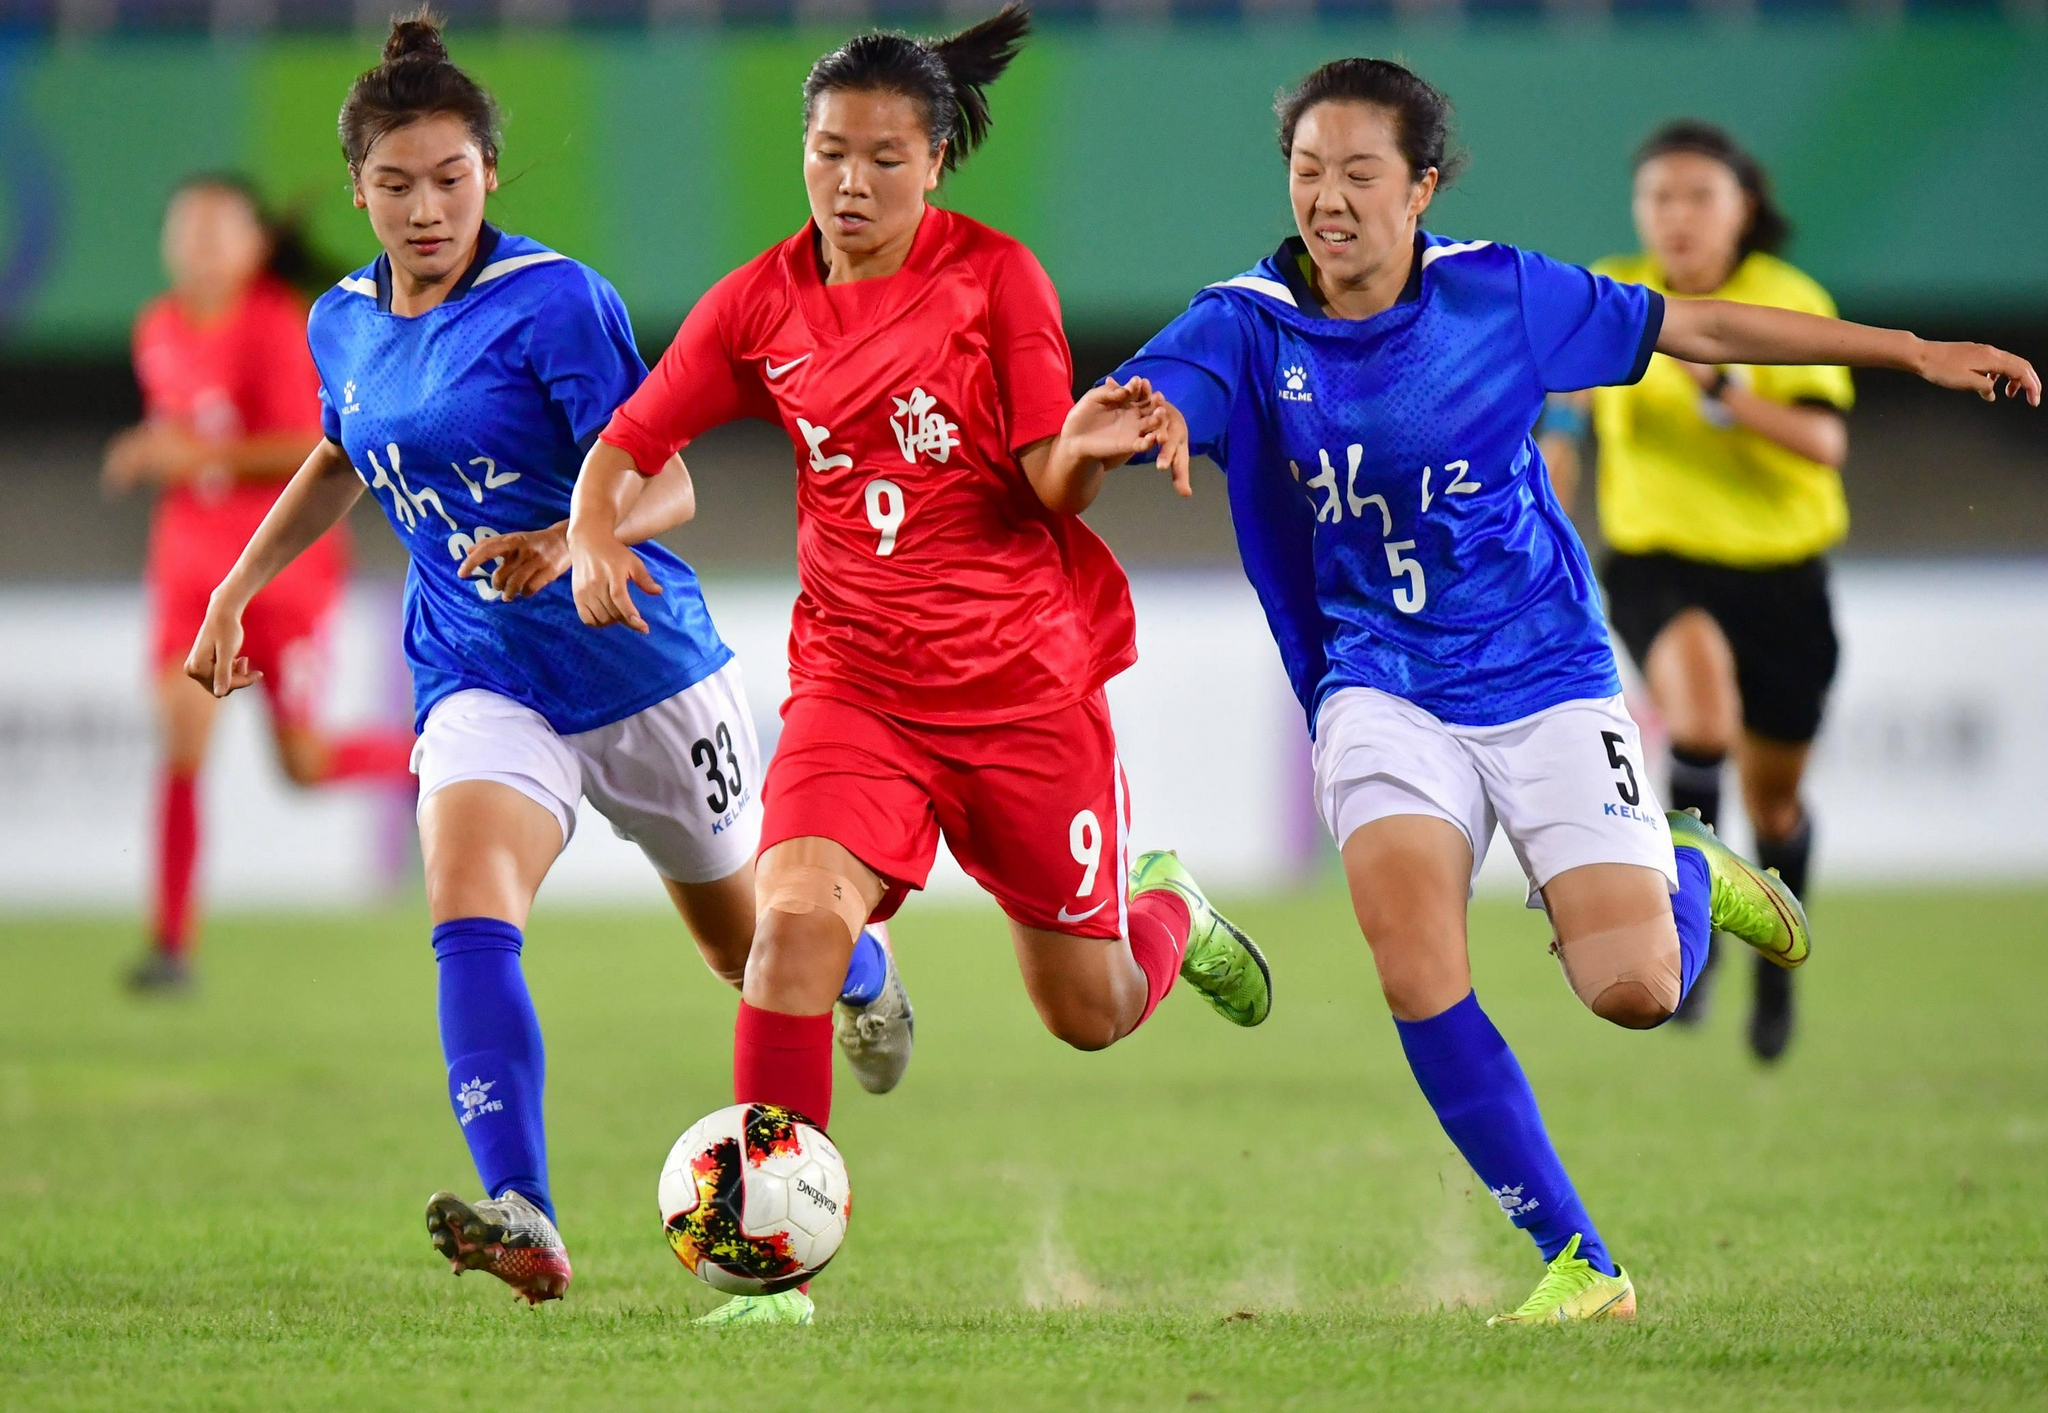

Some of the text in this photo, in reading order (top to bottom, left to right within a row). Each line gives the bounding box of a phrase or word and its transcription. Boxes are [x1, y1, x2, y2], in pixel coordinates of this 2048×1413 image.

[795, 387, 960, 473] 上海
[864, 479, 906, 557] 9
[1384, 539, 1426, 614] 5
[690, 720, 742, 815] 33
[1600, 730, 1641, 807] 5
[711, 787, 751, 836] KELME
[1603, 802, 1658, 831] KELME
[1069, 809, 1103, 898] 9
